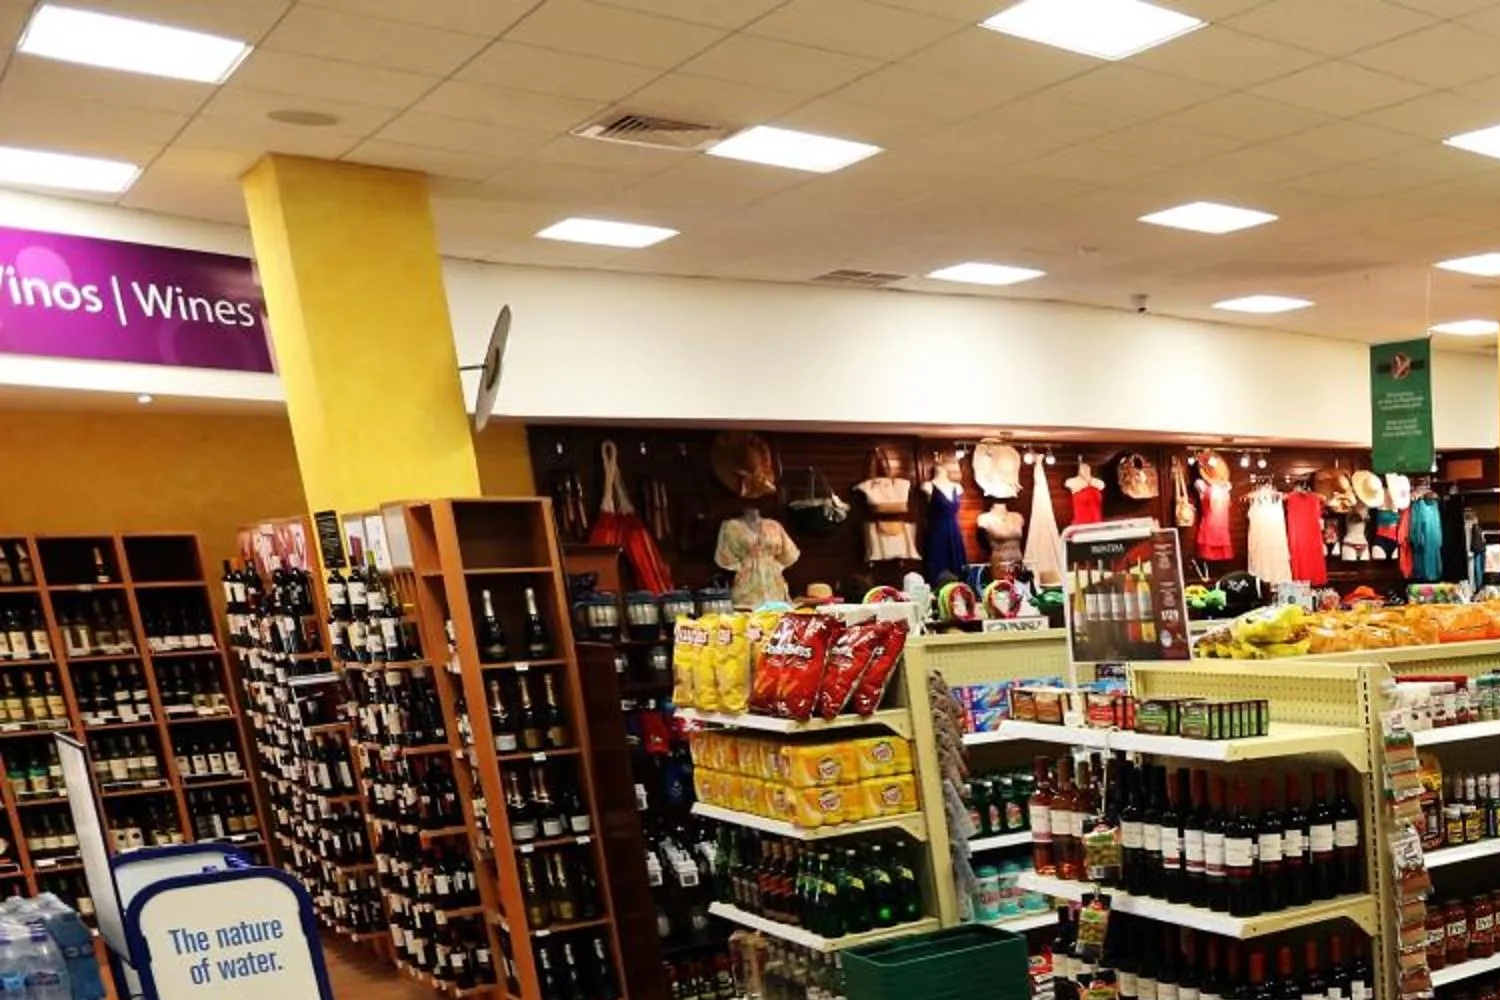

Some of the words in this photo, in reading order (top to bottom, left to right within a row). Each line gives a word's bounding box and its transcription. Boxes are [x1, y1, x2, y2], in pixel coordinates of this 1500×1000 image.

[132, 281, 255, 327] Wines
[169, 929, 210, 956] The
[217, 918, 284, 949] nature
[190, 958, 211, 985] of
[217, 951, 283, 980] water.
